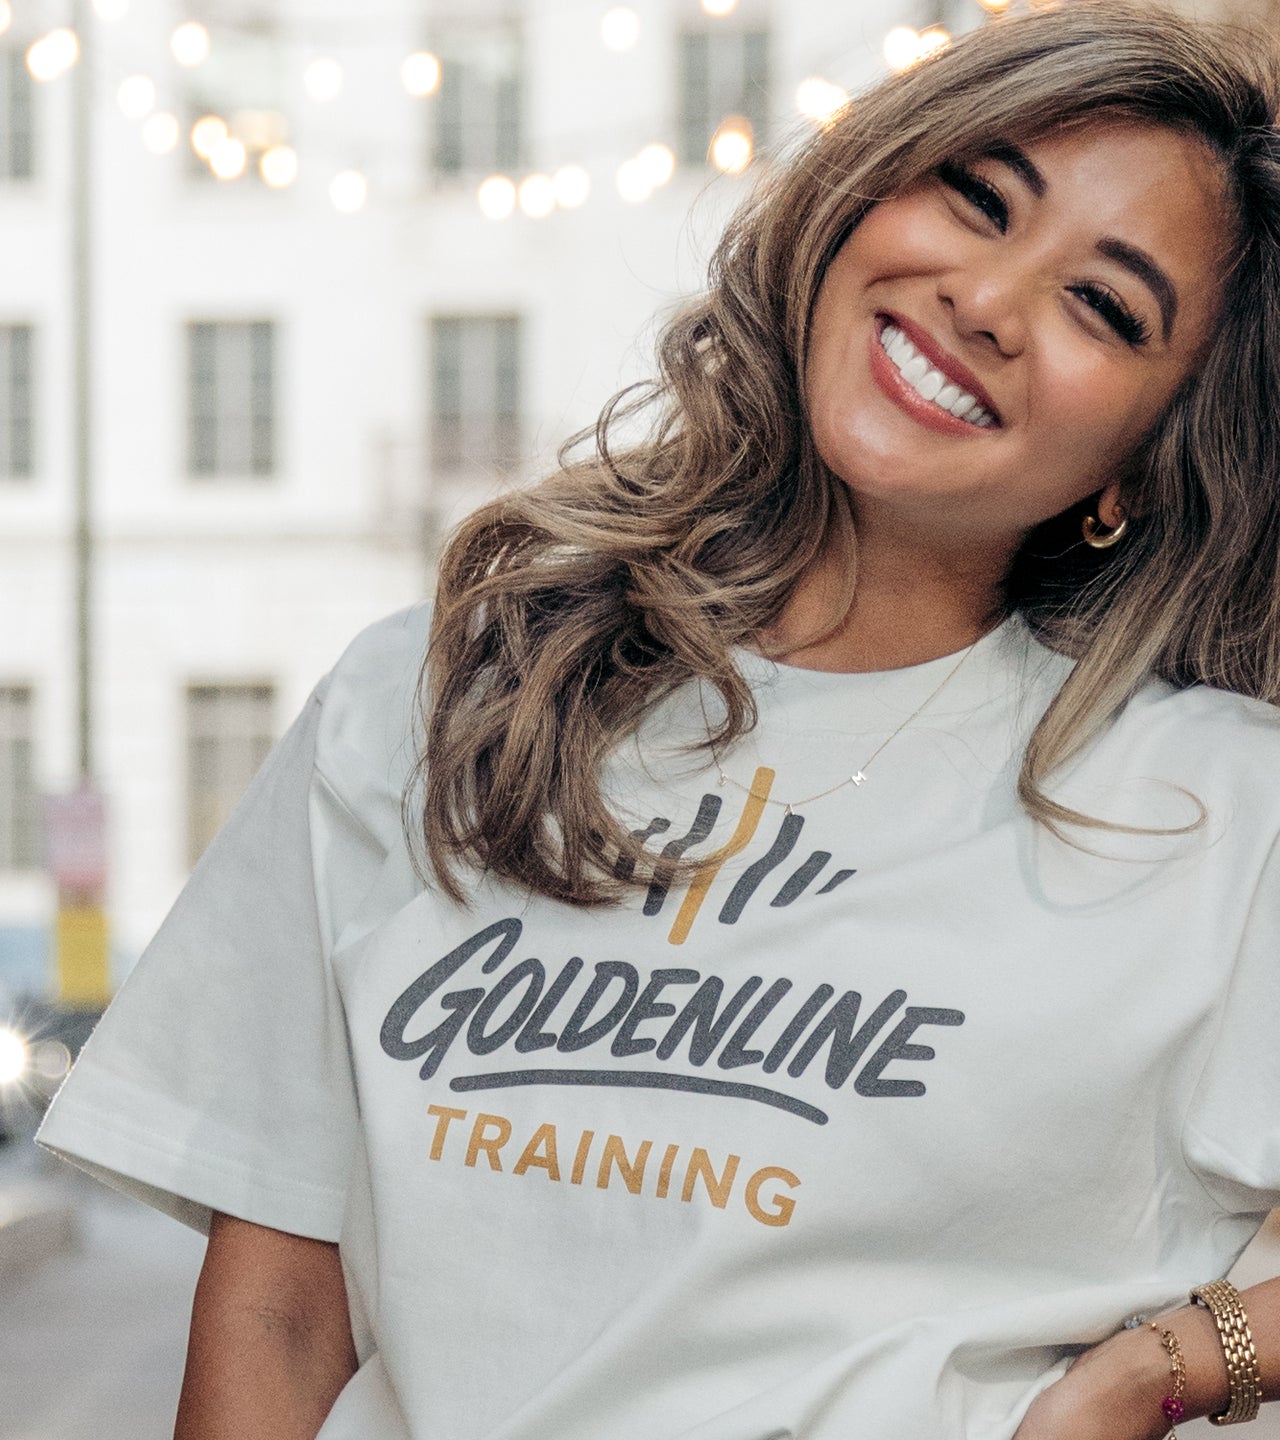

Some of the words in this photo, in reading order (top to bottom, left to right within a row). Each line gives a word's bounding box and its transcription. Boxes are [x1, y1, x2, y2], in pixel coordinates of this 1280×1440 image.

[851, 770, 867, 786] M
[379, 917, 966, 1098] GOLDENLINE
[426, 1104, 802, 1227] TRAINING
